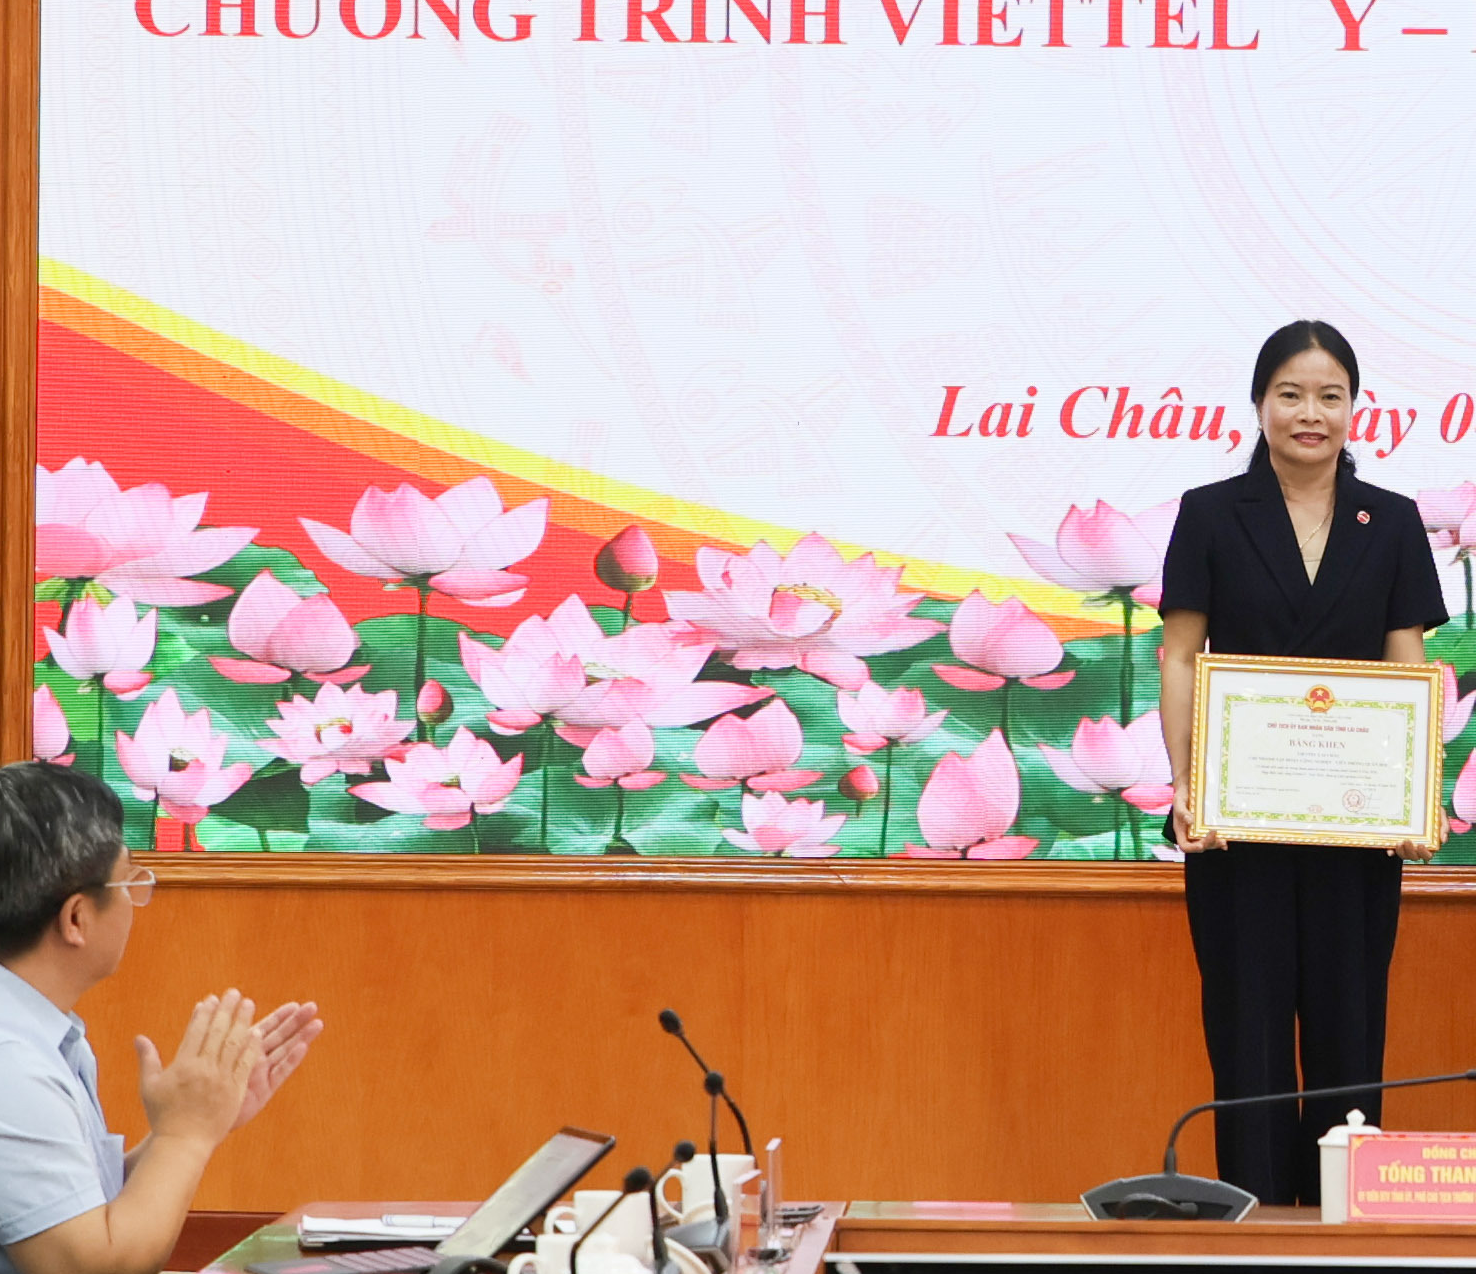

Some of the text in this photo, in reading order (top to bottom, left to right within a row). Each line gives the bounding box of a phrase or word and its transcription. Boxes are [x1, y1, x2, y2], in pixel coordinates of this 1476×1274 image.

[932, 385, 1038, 439] Lai
[1060, 385, 1243, 453] Châu,
[1346, 389, 1418, 460] ày
[1378, 1159, 1426, 1184] TỐNG
